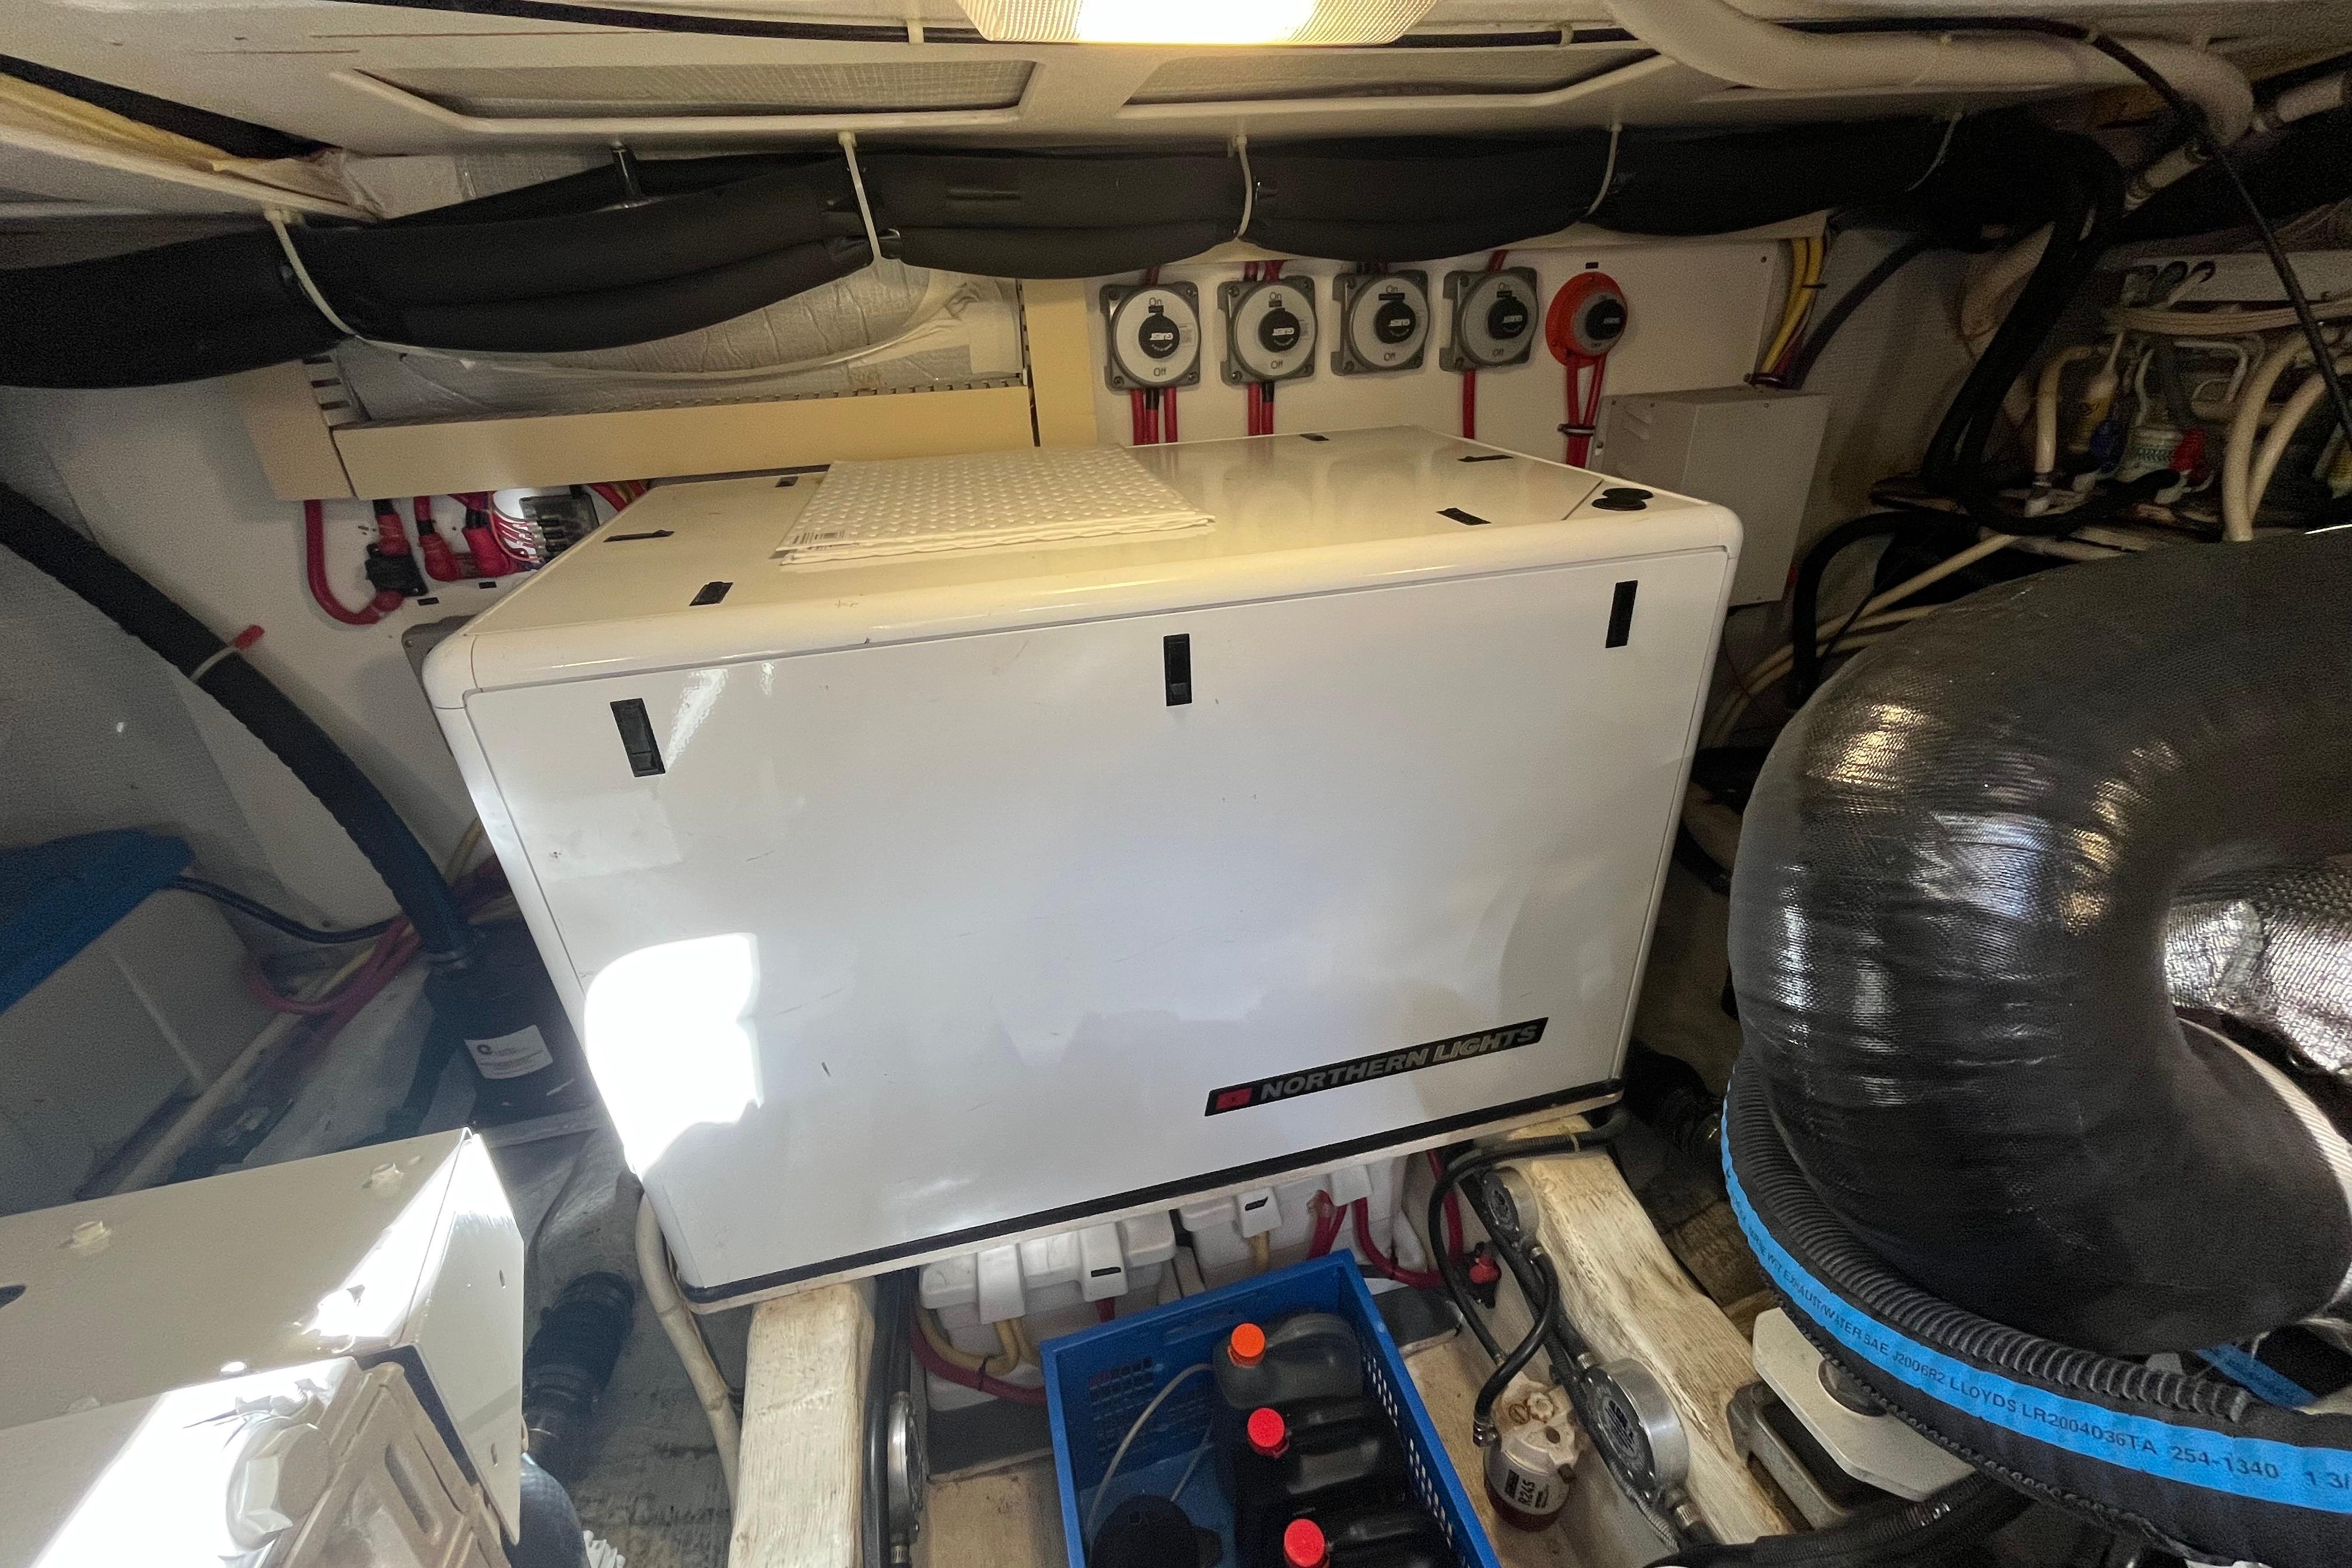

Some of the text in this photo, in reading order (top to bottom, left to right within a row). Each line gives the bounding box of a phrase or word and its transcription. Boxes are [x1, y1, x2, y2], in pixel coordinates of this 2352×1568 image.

[1386, 285, 1398, 294] On
[1269, 292, 1282, 300] On
[1149, 297, 1163, 306] On
[1384, 352, 1396, 362] Off
[1270, 360, 1283, 369] Off
[1153, 368, 1167, 377] Off
[1261, 1024, 1538, 1101] NORTHERN LIGHTS
[1864, 1334, 1889, 1356] SAE
[1948, 1376, 2017, 1413] LLOYDS
[2021, 1403, 2158, 1455] LR2004036TA
[2170, 1444, 2280, 1479] 254-1340
